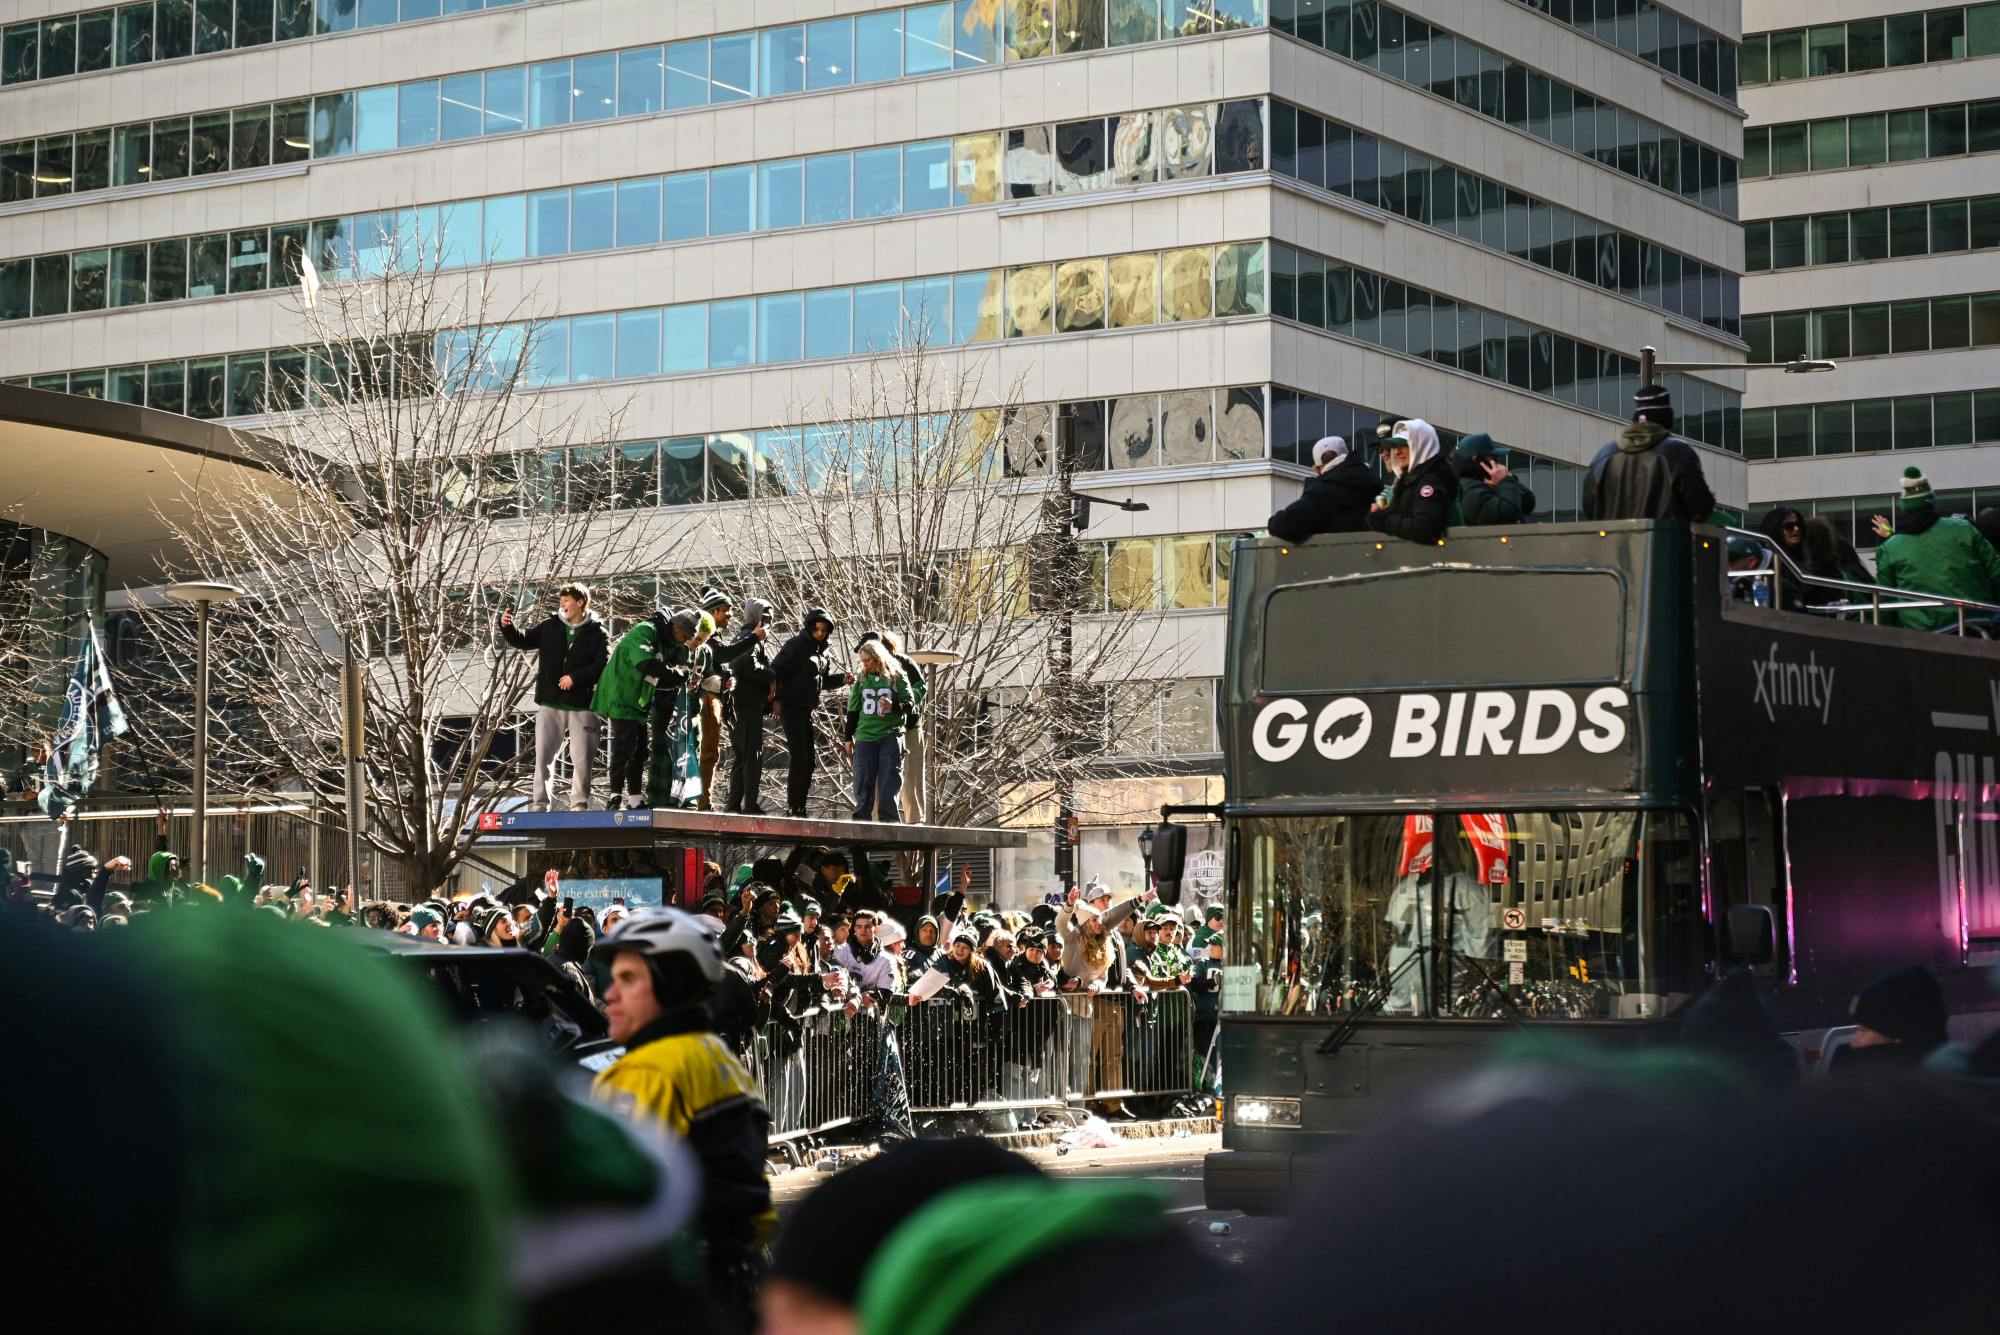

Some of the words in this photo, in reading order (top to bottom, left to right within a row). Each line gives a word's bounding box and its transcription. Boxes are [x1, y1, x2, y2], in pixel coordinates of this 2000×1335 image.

[1752, 641, 1835, 725] xfinity
[1252, 697, 1372, 762] GO
[1389, 687, 1629, 758] BIRDS
[506, 817, 516, 825] 27
[566, 887, 582, 899] the
[584, 888, 608, 899] extra
